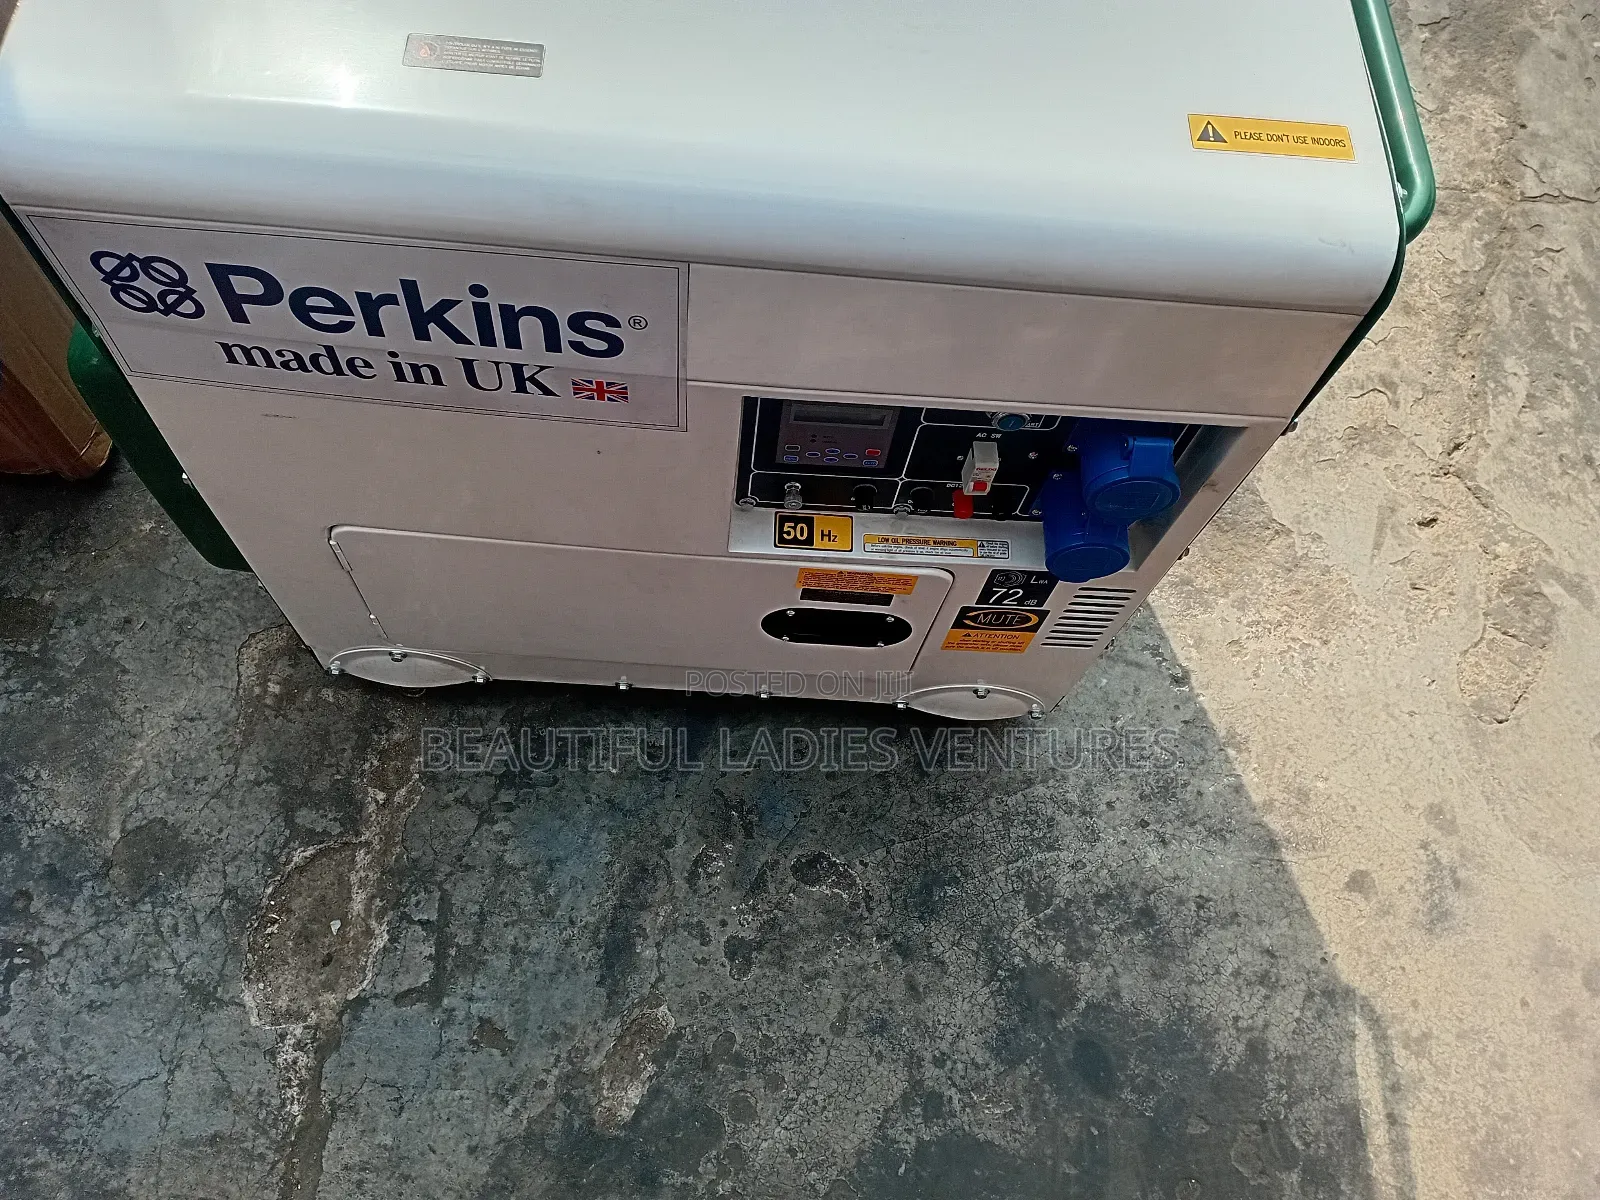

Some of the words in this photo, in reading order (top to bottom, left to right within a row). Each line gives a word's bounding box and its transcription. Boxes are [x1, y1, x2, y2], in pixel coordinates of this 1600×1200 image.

[1233, 130, 1265, 142] PLEASE
[1266, 132, 1290, 143] DON'T
[1292, 135, 1309, 145] USE
[1310, 136, 1347, 148] INDOORS
[203, 261, 626, 358] Perkins
[214, 338, 377, 381] made
[386, 350, 448, 387] in
[454, 356, 562, 398] UK
[782, 522, 808, 541] 50
[820, 529, 838, 543] Hz
[901, 538, 932, 546] PRESSURE
[932, 539, 958, 547] WARNING
[988, 587, 1024, 605] 72
[976, 613, 1027, 625] MUTE
[972, 632, 1020, 640] ATTENTION
